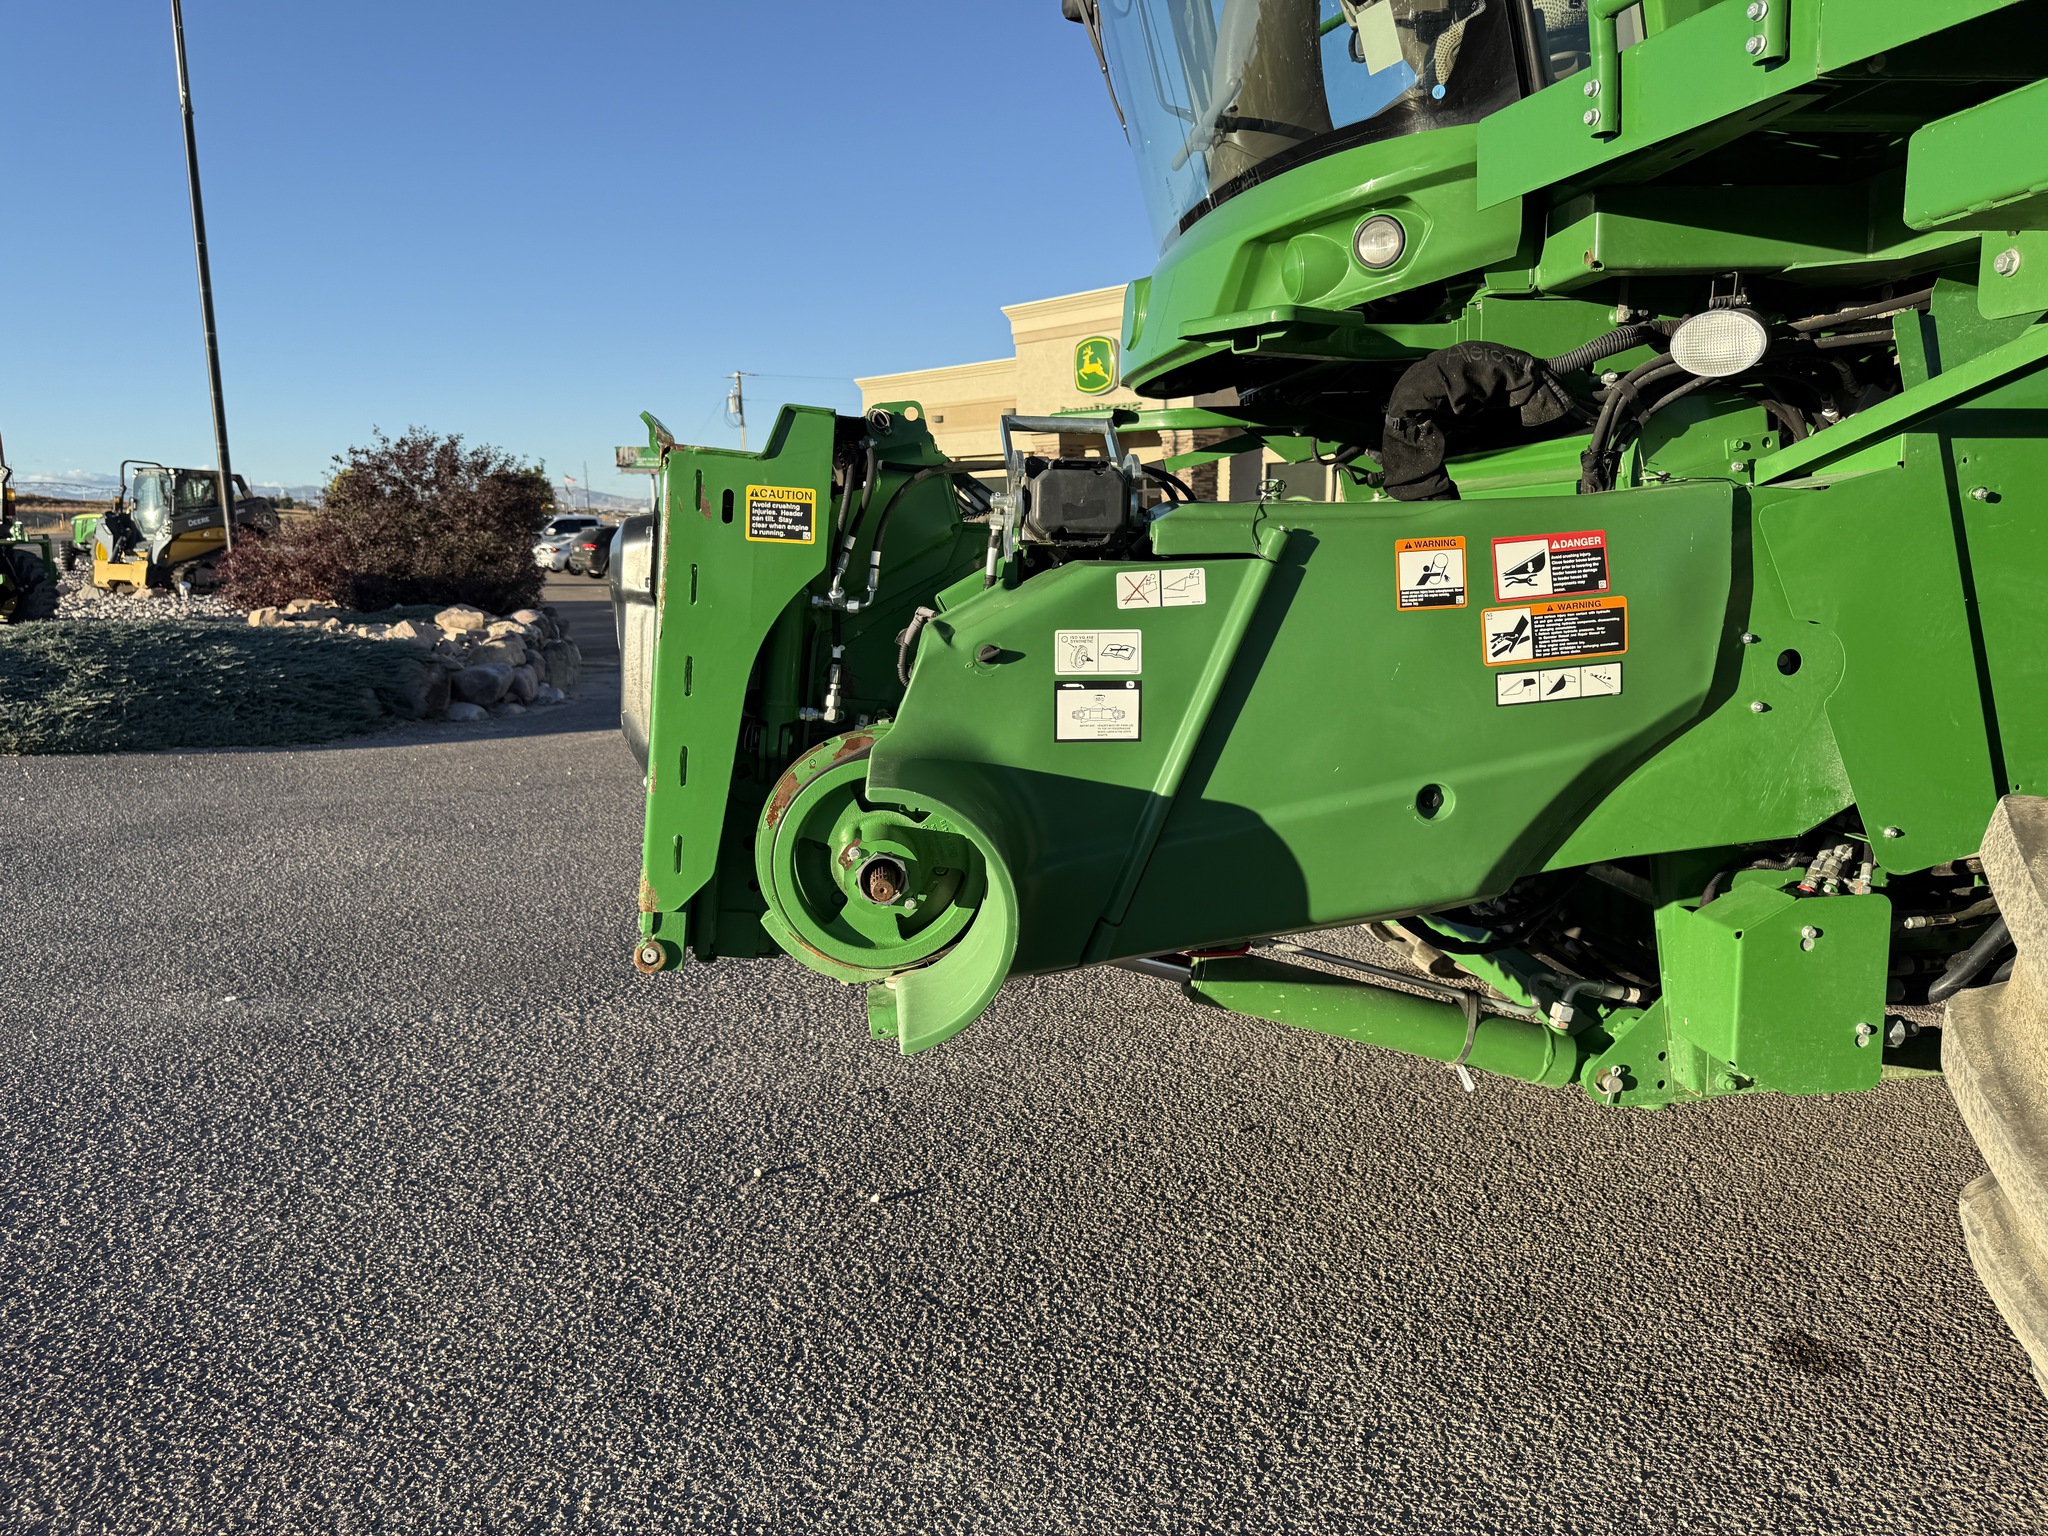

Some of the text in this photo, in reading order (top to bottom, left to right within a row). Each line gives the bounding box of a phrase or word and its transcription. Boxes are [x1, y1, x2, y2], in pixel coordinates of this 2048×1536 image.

[760, 488, 812, 500] CAUTION
[772, 503, 800, 511] crushing
[188, 516, 210, 527] DEERE
[778, 516, 793, 524] Stay
[1414, 539, 1456, 548] WARNING
[1560, 536, 1601, 548] DANGER
[1557, 600, 1602, 610] WARNING
